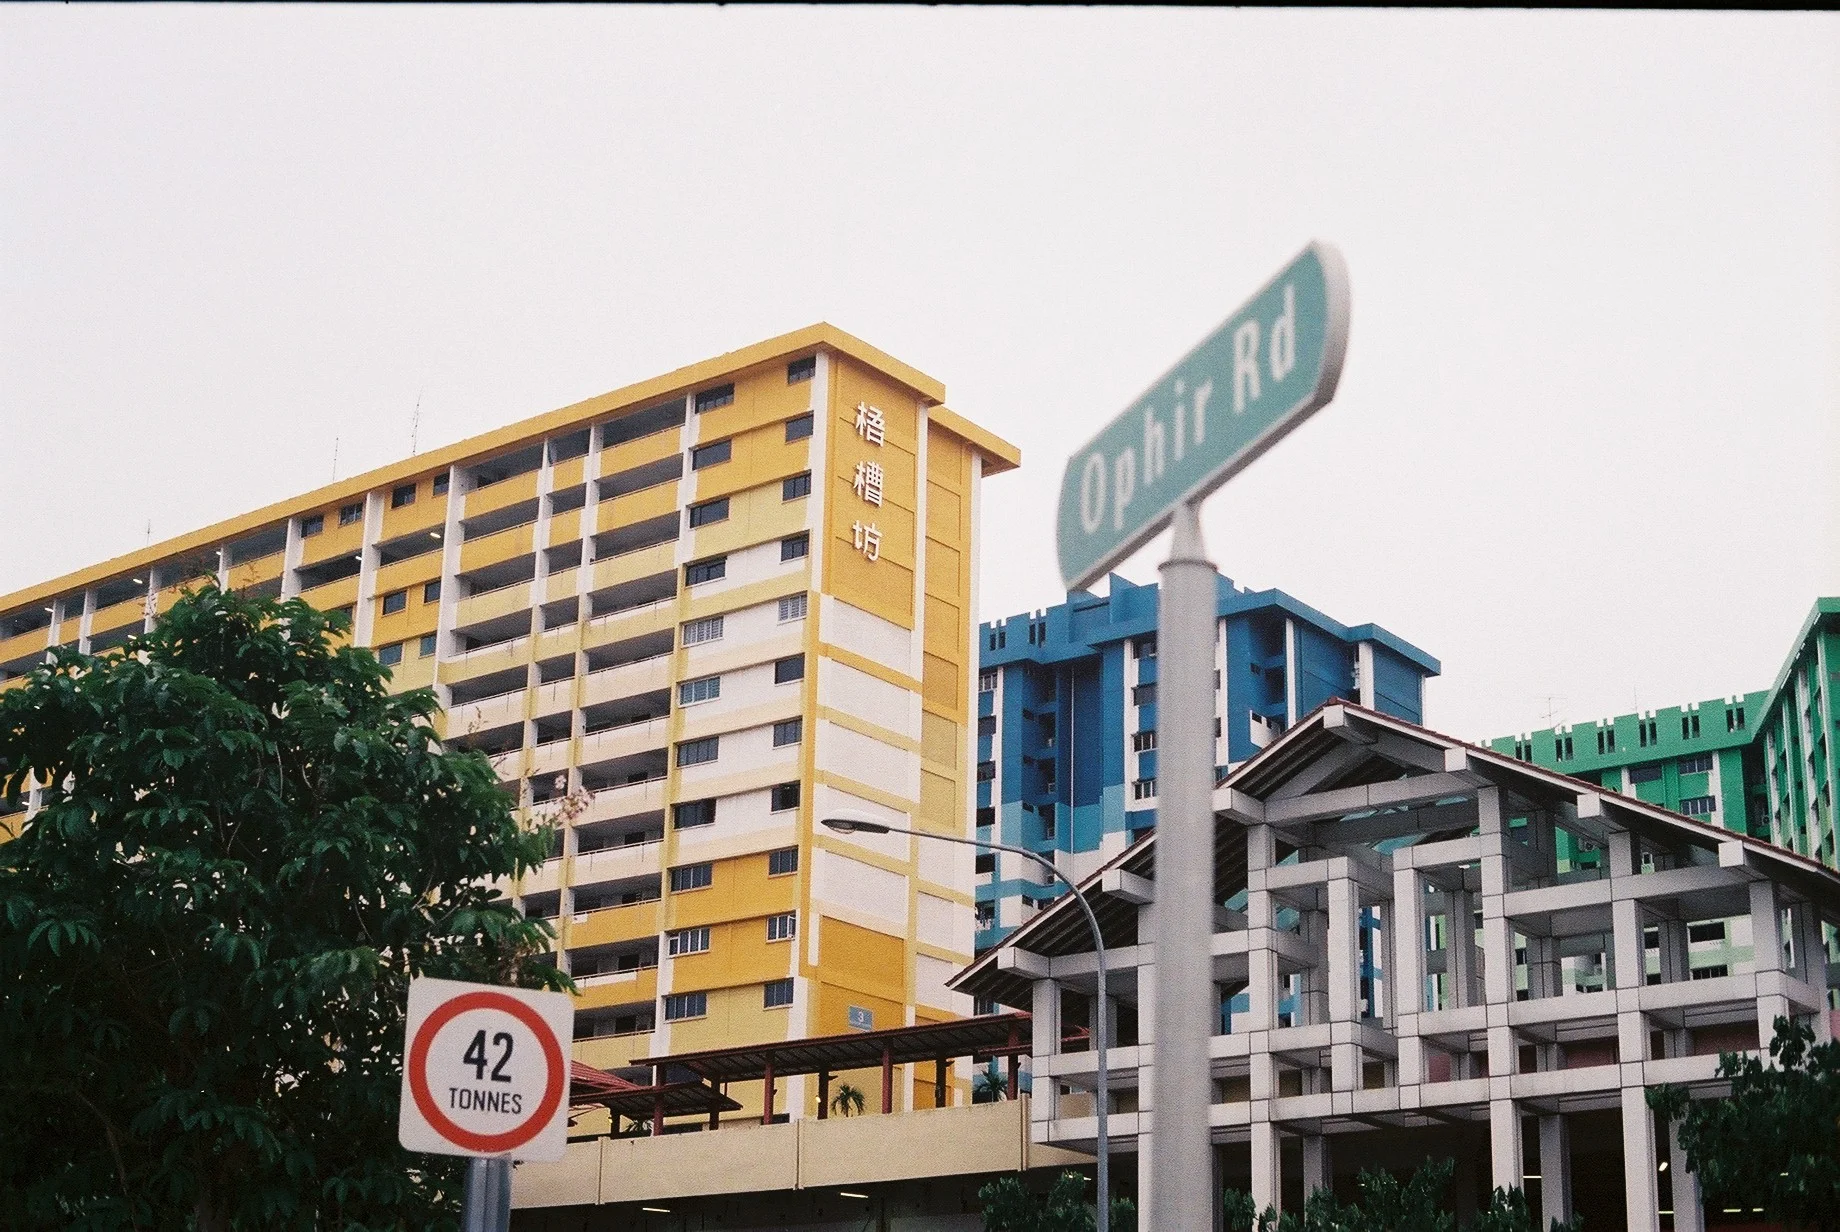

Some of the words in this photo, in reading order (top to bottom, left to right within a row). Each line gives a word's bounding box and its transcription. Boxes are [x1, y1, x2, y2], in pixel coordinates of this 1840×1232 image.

[1079, 377, 1213, 534] Ophir
[1232, 283, 1296, 416] Rd
[852, 401, 886, 562] 梧槽坊
[449, 1087, 522, 1115] TONNES
[462, 1029, 514, 1083] 42
